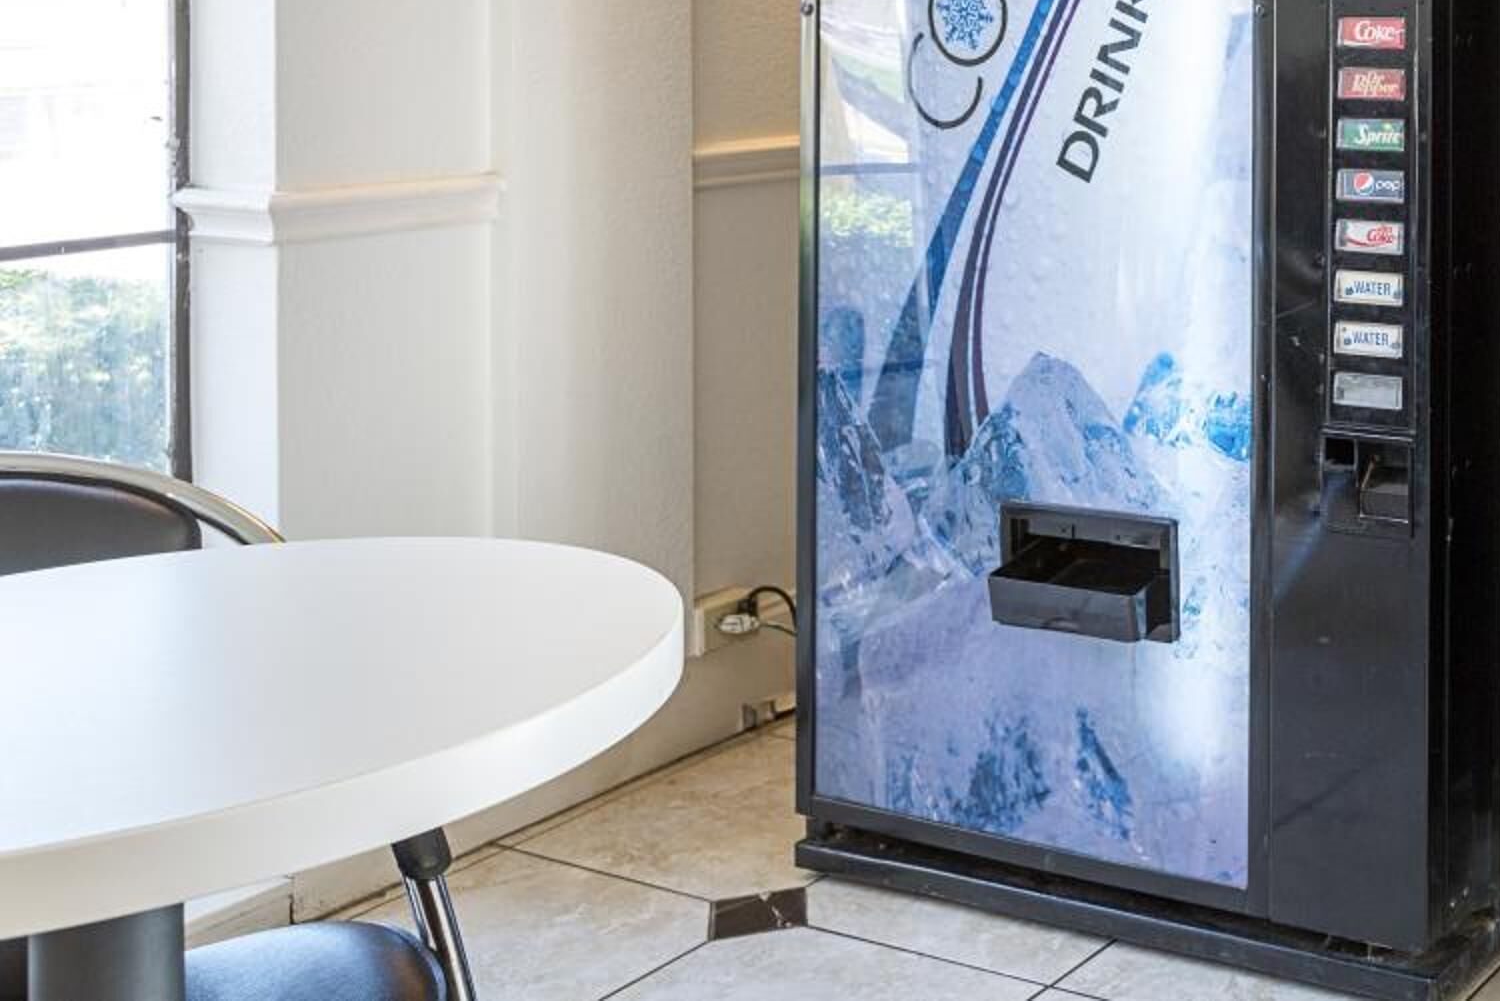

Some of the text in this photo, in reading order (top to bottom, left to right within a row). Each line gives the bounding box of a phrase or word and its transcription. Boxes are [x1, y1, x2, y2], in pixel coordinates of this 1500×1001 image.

[1353, 20, 1397, 42] Coke
[1354, 123, 1402, 146] Sprite
[1353, 280, 1391, 296] WATER
[1351, 331, 1390, 346] WATER
